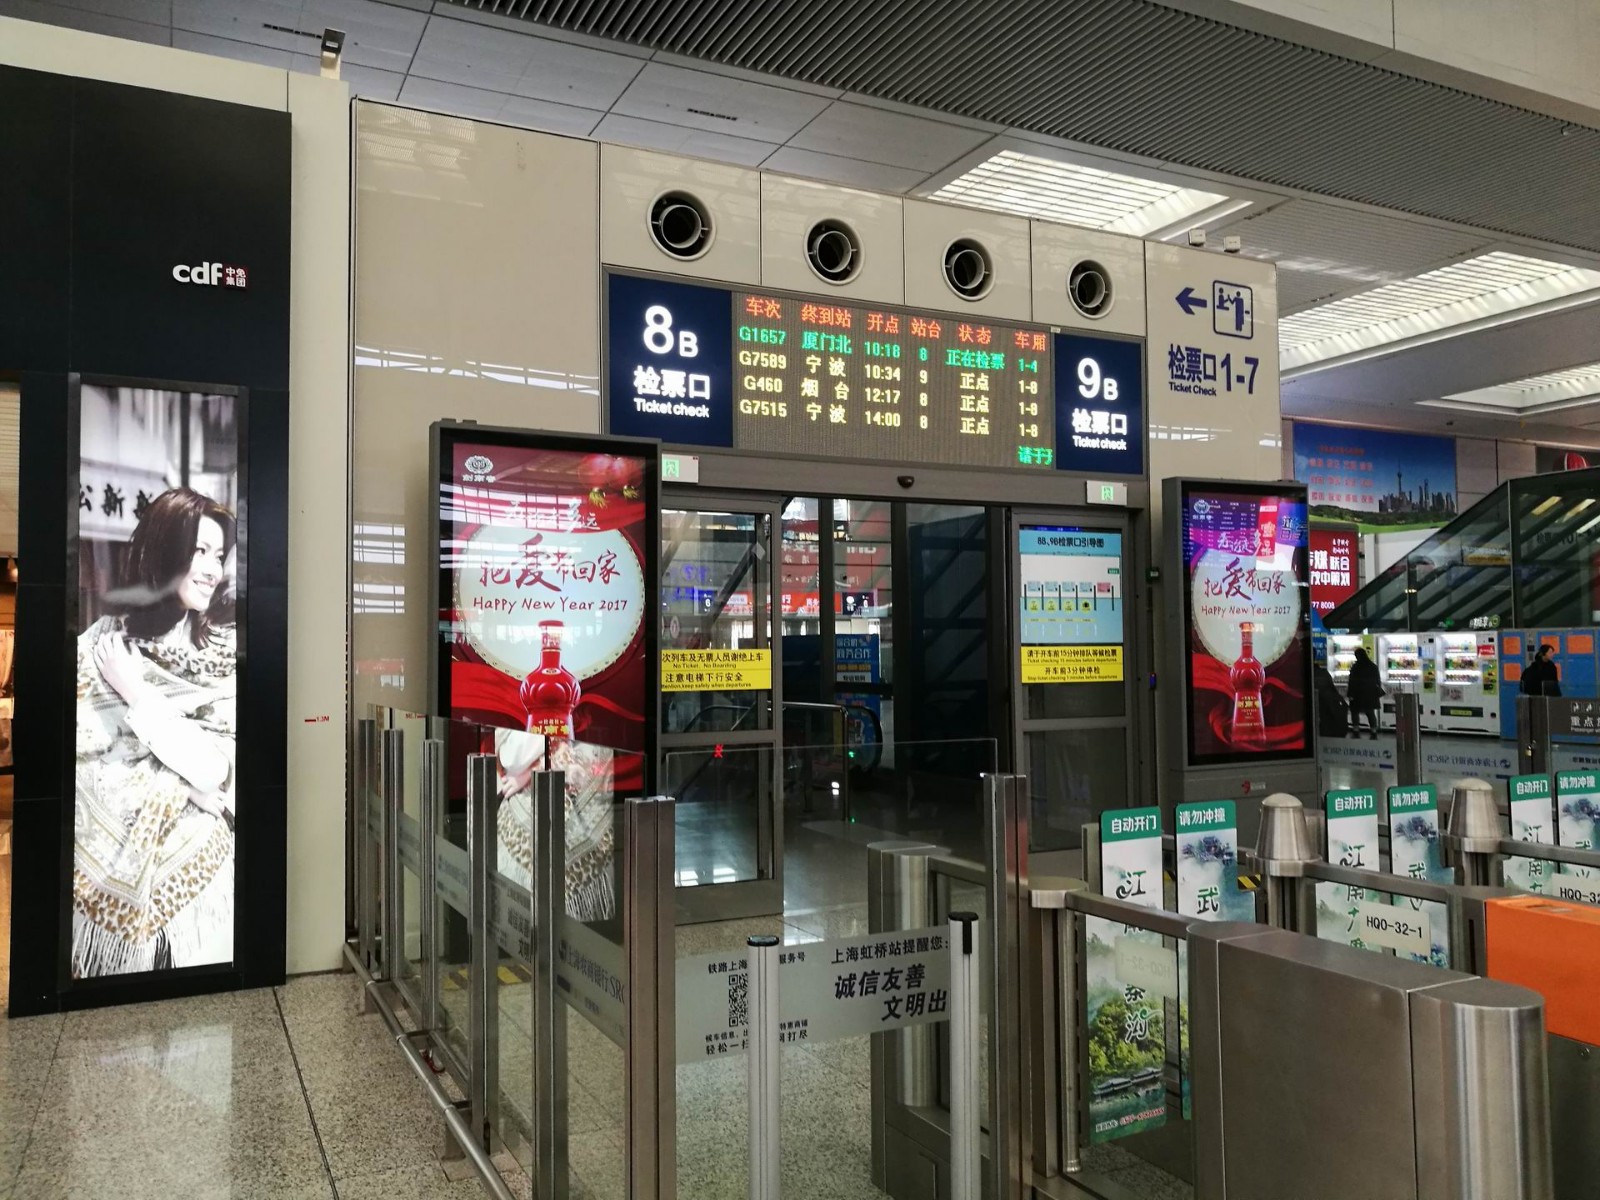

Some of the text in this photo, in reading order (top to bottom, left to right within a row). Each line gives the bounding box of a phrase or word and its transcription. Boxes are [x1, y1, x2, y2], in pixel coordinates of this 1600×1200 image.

[172, 261, 223, 285] cdf
[746, 297, 1047, 352] 车次 终到站 开点 站台 状态 车厢
[738, 326, 787, 346] G1657
[801, 331, 853, 355] 厦门北
[864, 341, 901, 359] 10:18
[918, 347, 928, 362] 8
[945, 349, 1006, 370] 正在检票
[633, 365, 711, 400] 检票口
[738, 350, 787, 370] G7589
[864, 364, 901, 382] 10:34
[919, 369, 928, 384] 9
[959, 372, 990, 392] 正点
[1018, 379, 1038, 395] 1-8
[743, 375, 783, 394] G460
[864, 387, 901, 405] 12:17
[919, 392, 929, 407] 8
[959, 394, 990, 414] 正点
[1018, 401, 1038, 417] 1-8
[1168, 381, 1217, 397] Ticket Check
[633, 397, 710, 418] Ticket check
[739, 399, 788, 418] G7515
[864, 410, 901, 428] 14:00
[919, 415, 929, 430] 8
[959, 417, 990, 436] 正点
[1018, 423, 1039, 438] 1-8
[1071, 408, 1128, 436] 检票口
[1072, 435, 1127, 451] Ticket check
[473, 596, 628, 615] Happy New Year 2017
[1201, 604, 1291, 618] Happy New Year 2017
[665, 672, 743, 683] 注意电梯下行安全
[1517, 780, 1548, 795] 自动开门
[1559, 775, 1596, 790] 请勿冲撞
[1335, 794, 1374, 812] 自动开门
[1391, 791, 1430, 808] 请勿冲撞
[1110, 814, 1157, 835] 自动开门
[1178, 807, 1227, 827] 请勿冲撞
[708, 952, 806, 975] 铁路上海 服务号
[835, 963, 926, 1000] 诚信友善
[881, 988, 948, 1022] 文明出
